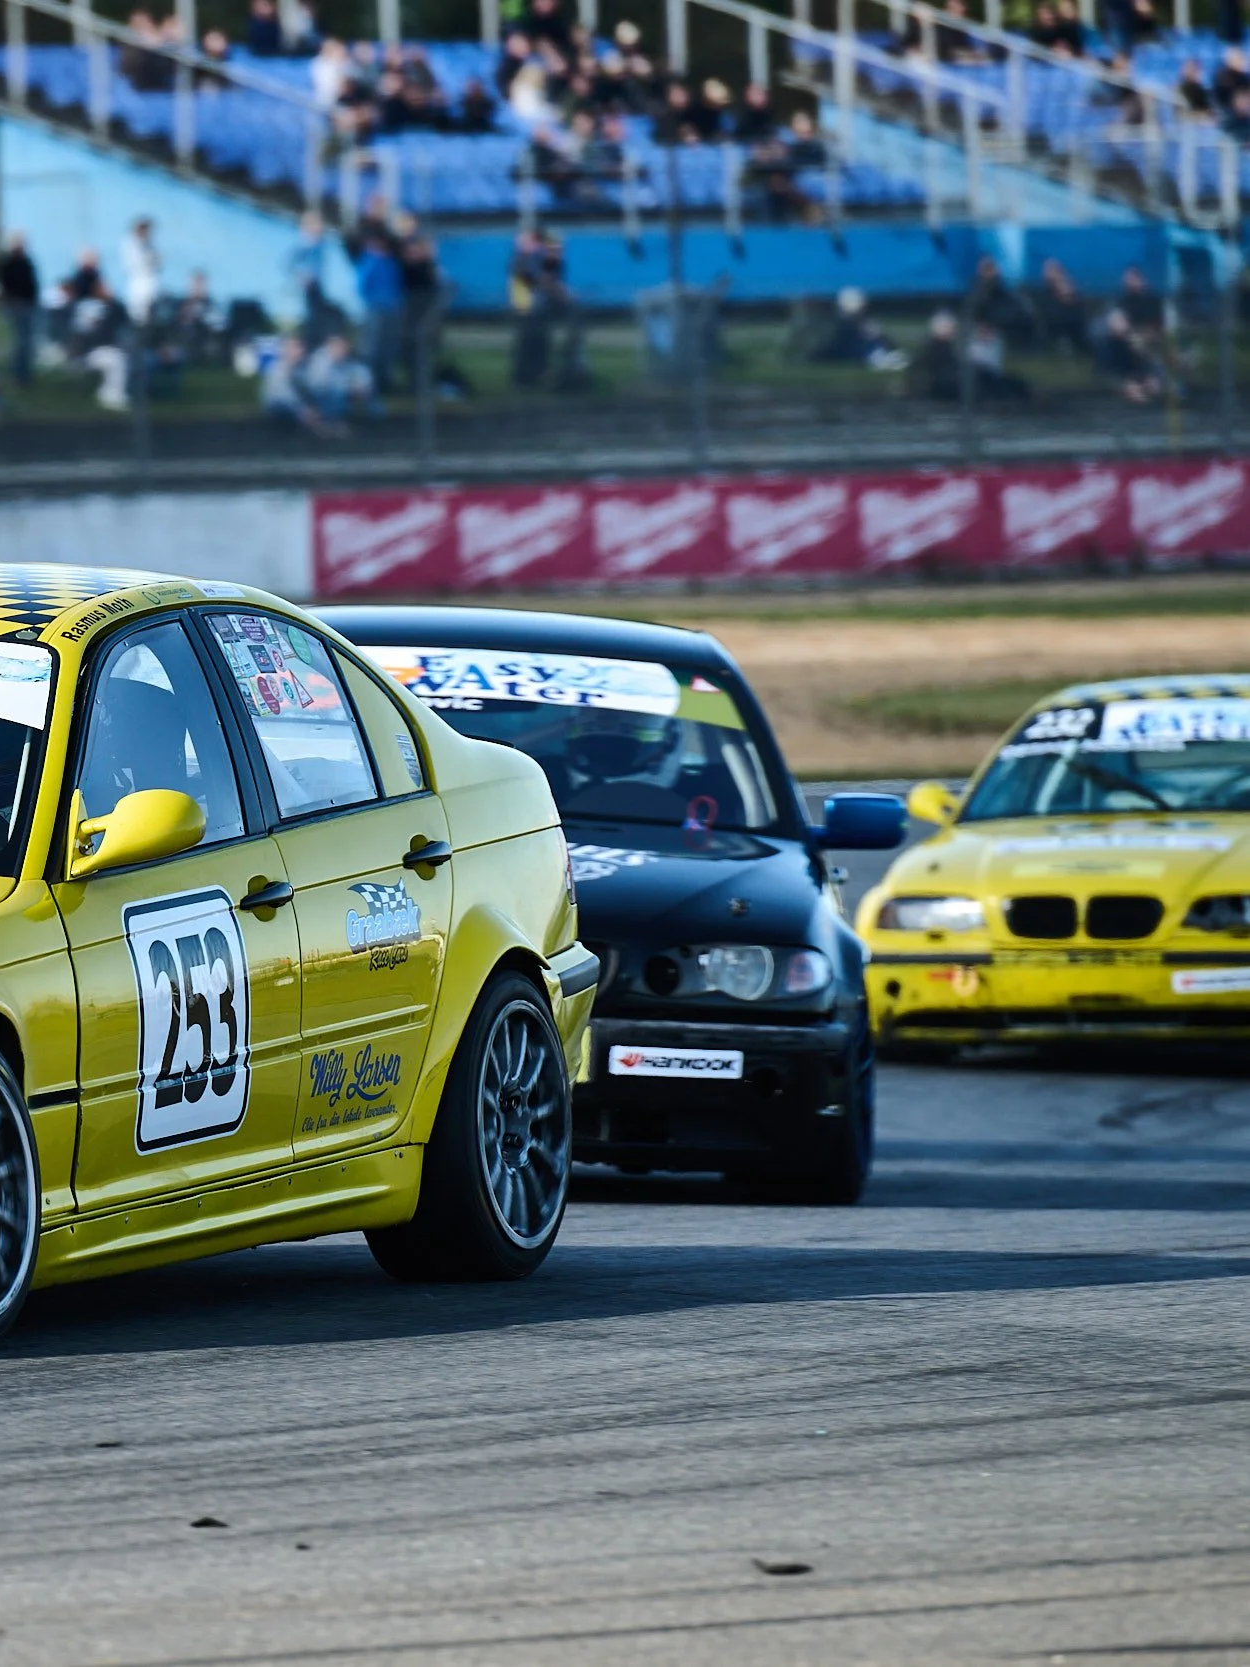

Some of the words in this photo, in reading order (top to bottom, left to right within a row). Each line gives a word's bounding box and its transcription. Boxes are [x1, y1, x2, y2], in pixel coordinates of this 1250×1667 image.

[60, 608, 107, 643] Rasmus
[102, 596, 135, 616] Moth
[148, 926, 238, 1110] 253
